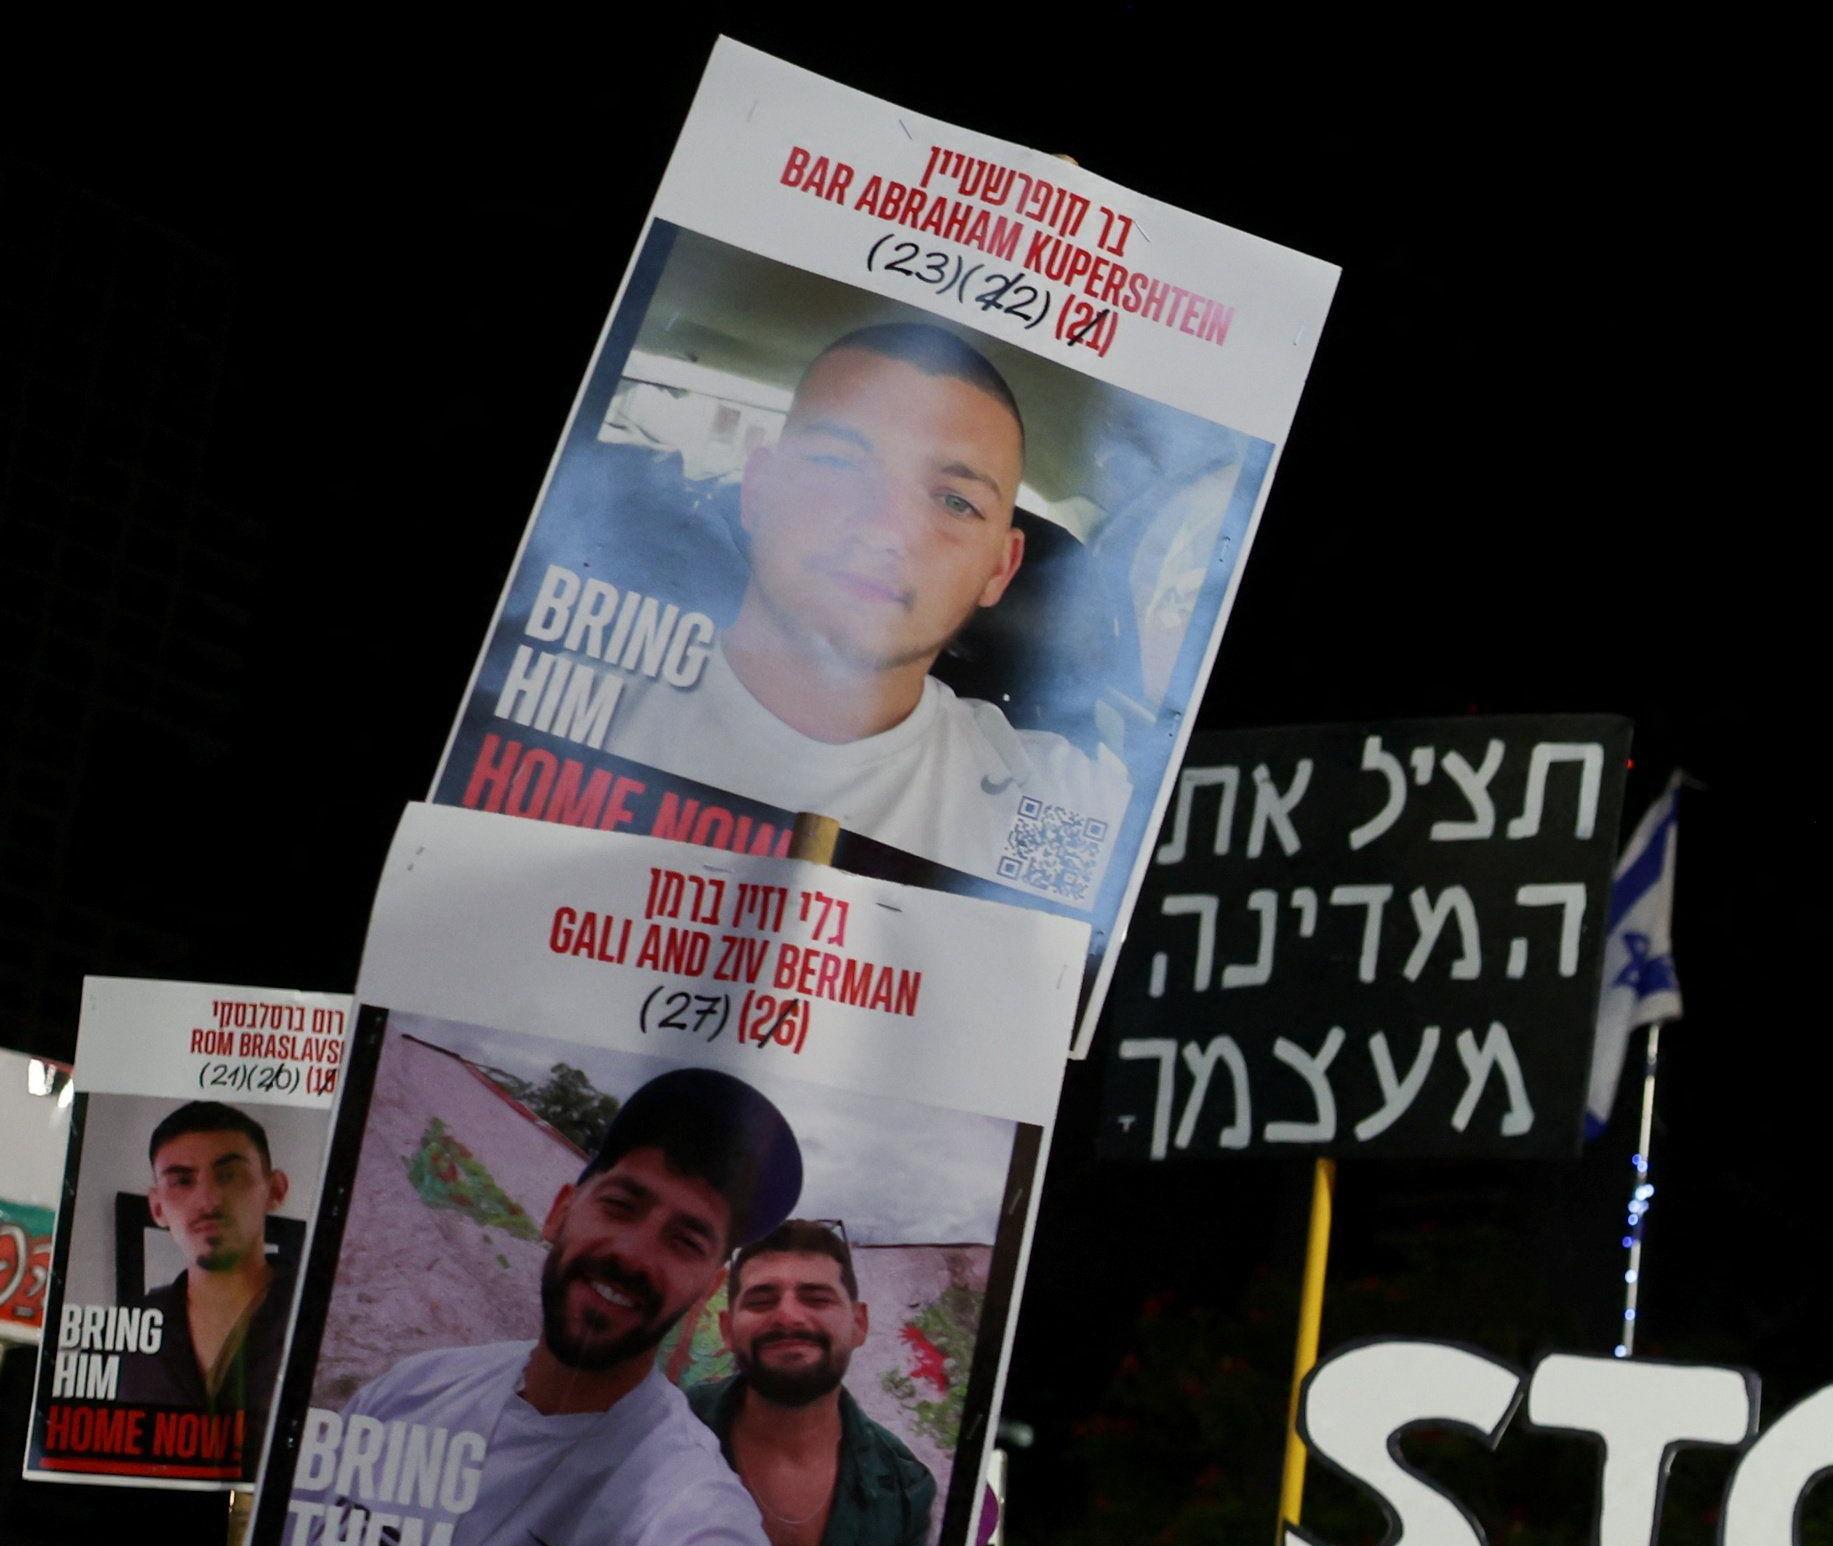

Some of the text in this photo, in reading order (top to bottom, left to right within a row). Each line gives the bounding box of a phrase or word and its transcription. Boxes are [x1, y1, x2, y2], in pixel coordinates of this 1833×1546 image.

[779, 146, 1235, 348] BAR ABRAHAM KUPERSHTEIN
[921, 146, 1135, 258] בר קופרשטיין
[525, 564, 716, 689] BRING
[494, 645, 626, 750] HIM
[462, 734, 645, 833] HOME
[1156, 736, 1604, 866] תציל את
[645, 867, 850, 948] גלי וזיו ברמן
[1148, 882, 1588, 998] המדינה
[549, 905, 922, 1017] GALI AND ZIV BERMAN
[190, 1028, 235, 1057] ROM
[211, 1000, 345, 1035] רום ברסלבסקי
[638, 985, 731, 1043] (27)
[52, 1351, 121, 1400] HIM
[59, 1303, 164, 1356] BRING
[45, 1402, 246, 1460] HOME NOW!
[294, 1406, 488, 1516] BRING
